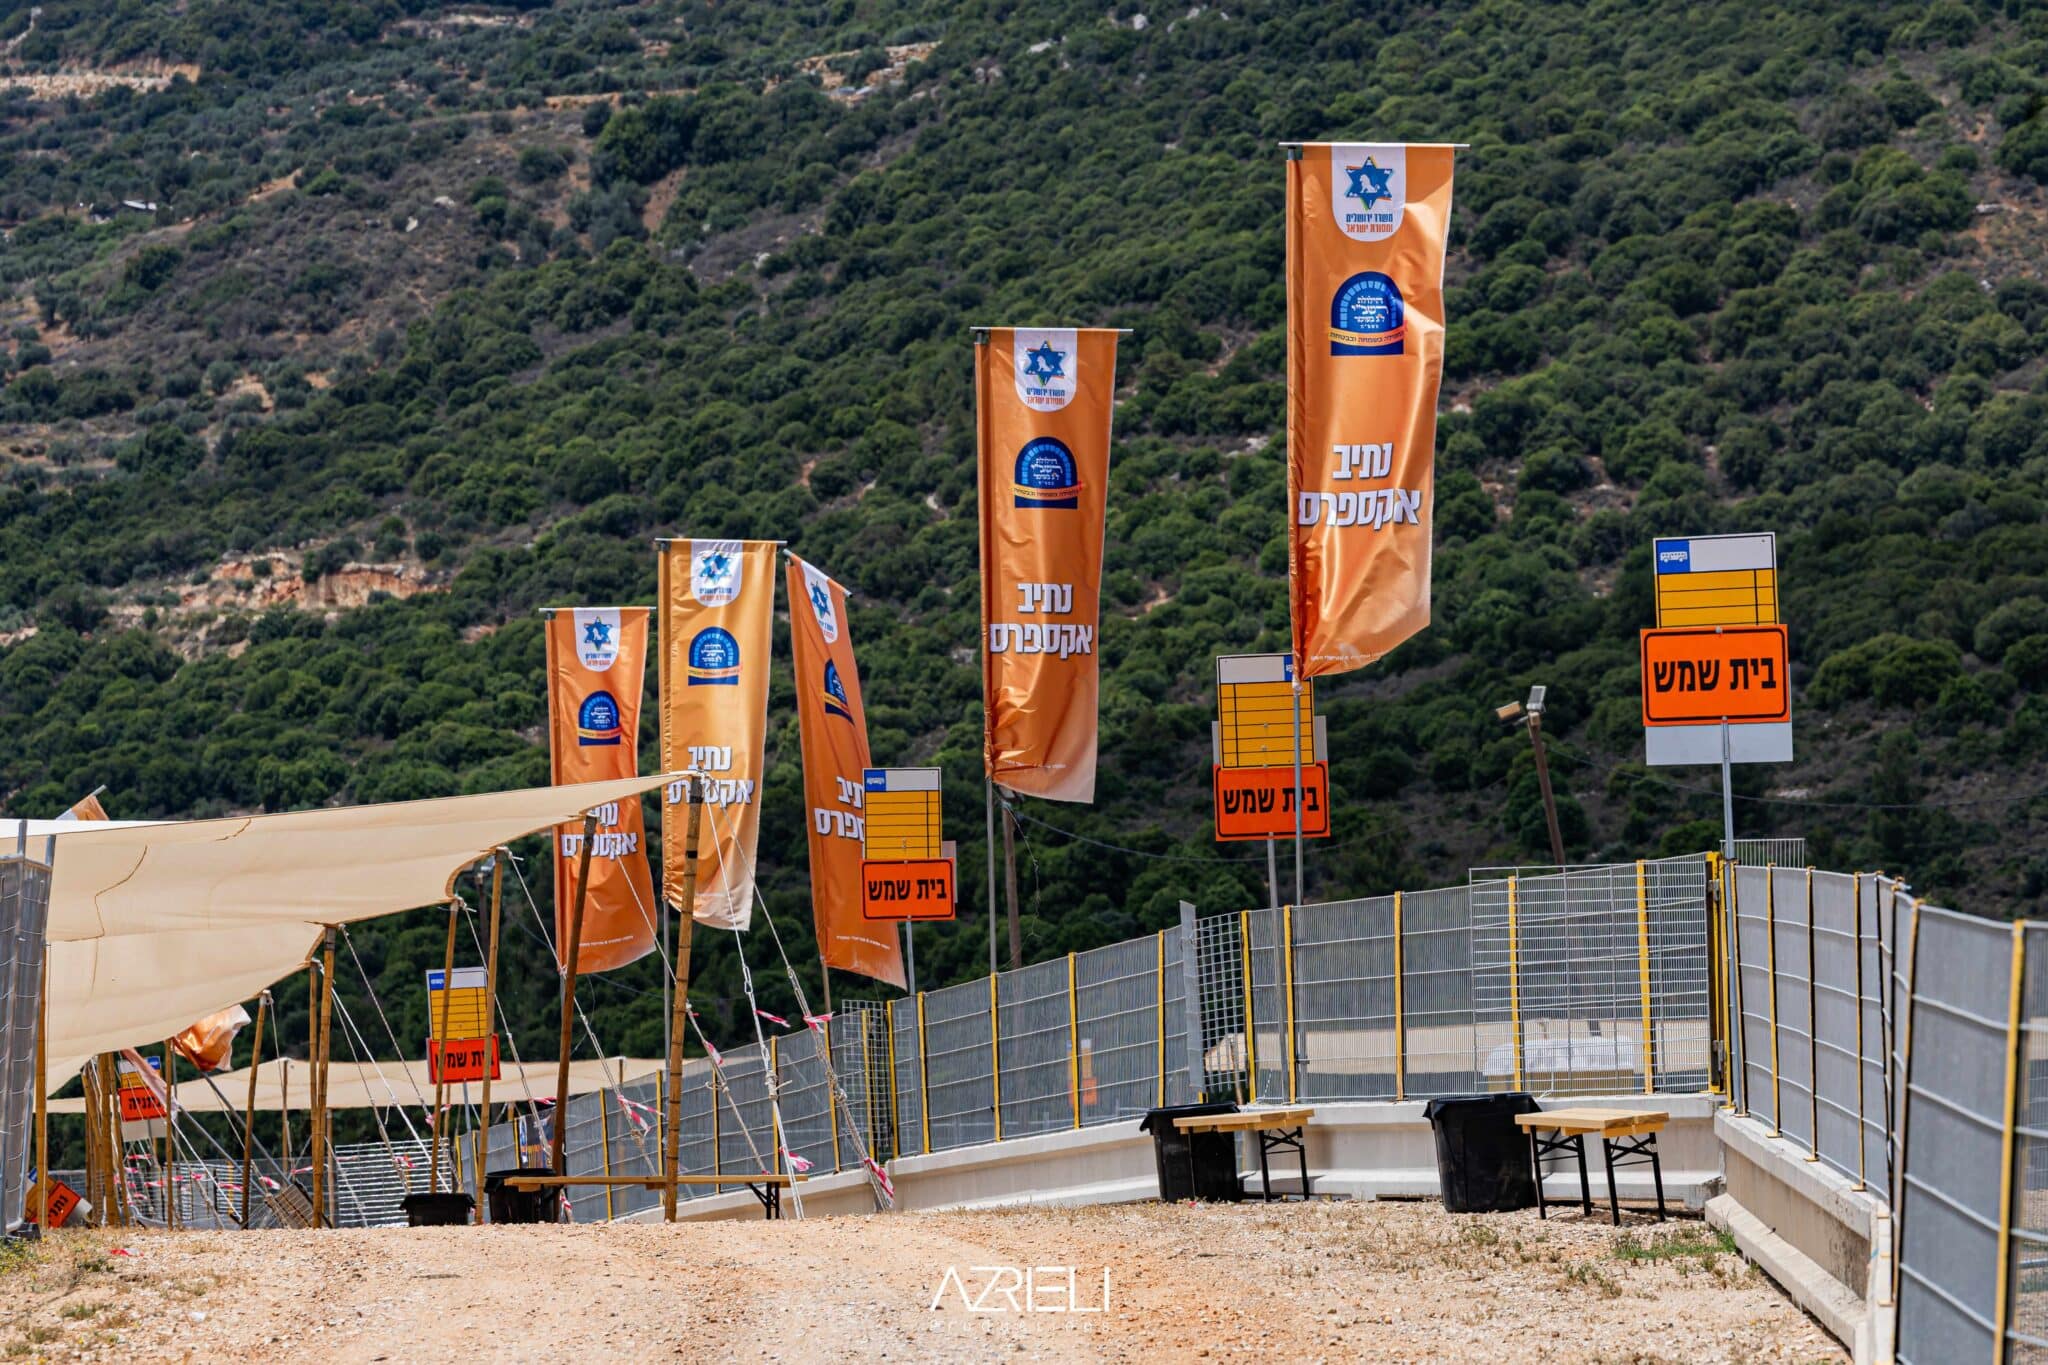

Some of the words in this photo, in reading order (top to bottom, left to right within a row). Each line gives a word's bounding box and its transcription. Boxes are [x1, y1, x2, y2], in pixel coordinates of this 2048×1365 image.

[1332, 442, 1393, 479] נתיב
[1298, 488, 1420, 530] אקספרס
[1017, 583, 1073, 613] נתיב
[989, 623, 1093, 659] אקספרס
[1653, 660, 1720, 692] שמש
[1730, 658, 1776, 690] בית
[687, 746, 732, 770] נתיב
[667, 779, 754, 808] אקסרס
[836, 776, 865, 809] תיב
[1223, 788, 1275, 814] שמש
[868, 880, 910, 901] שמש
[917, 878, 947, 900] בית
[471, 1050, 494, 1067] ית
